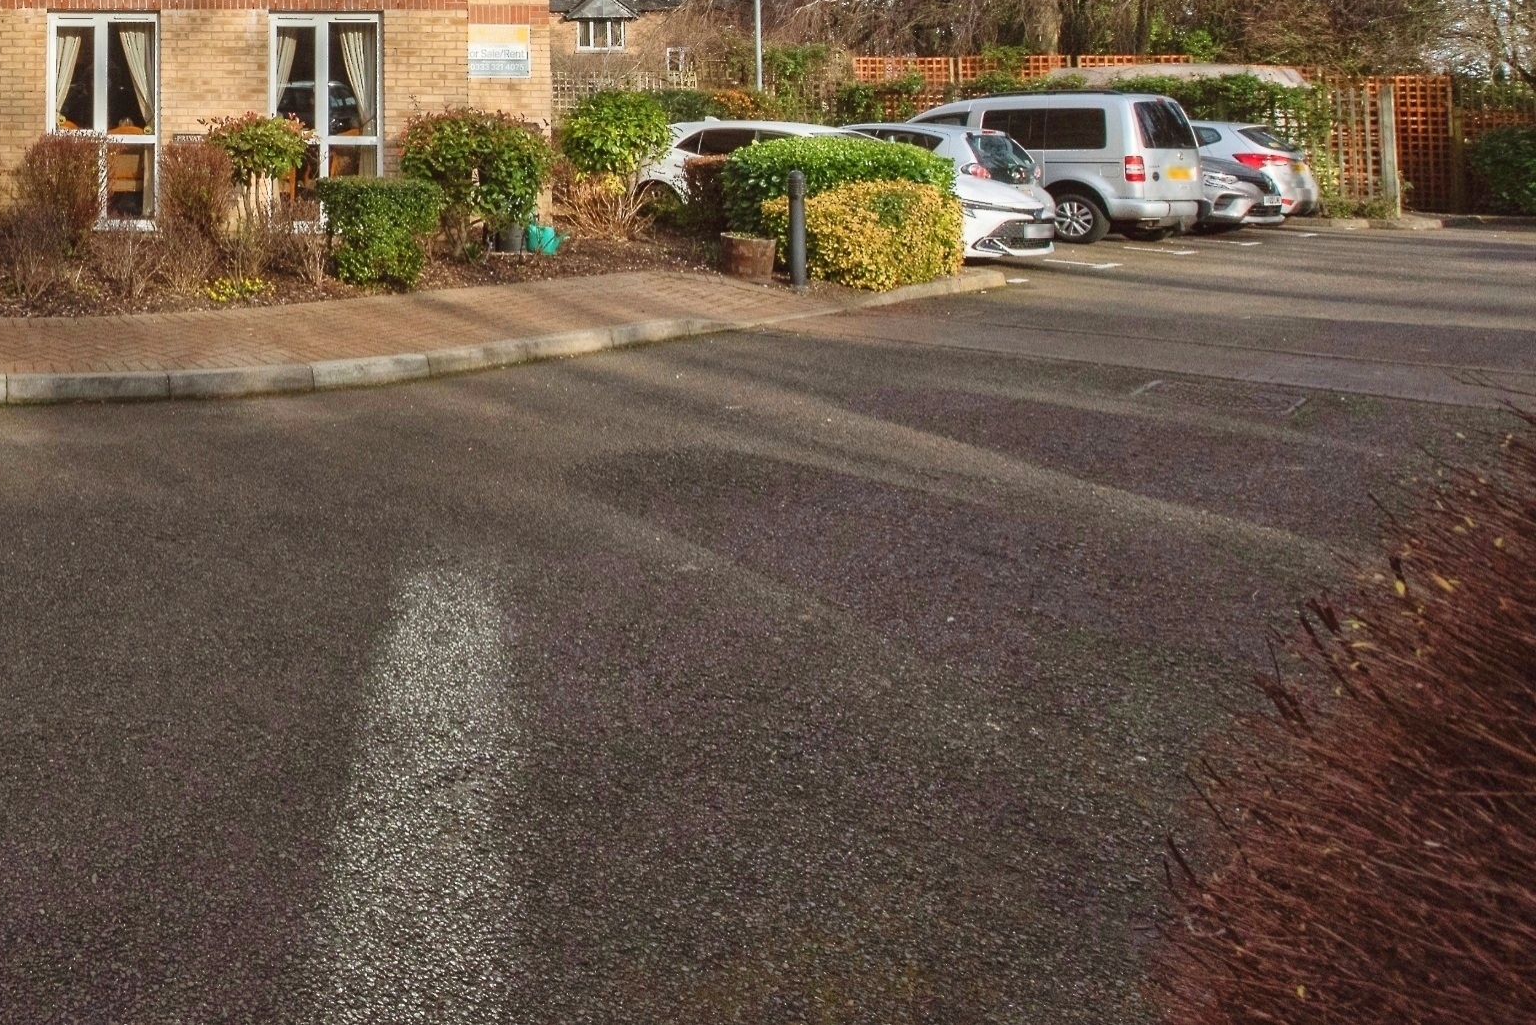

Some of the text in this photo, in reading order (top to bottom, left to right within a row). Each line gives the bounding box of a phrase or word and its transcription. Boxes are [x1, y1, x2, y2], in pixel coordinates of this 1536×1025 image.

[469, 49, 525, 59] or Sale/Rent
[470, 63, 525, 71] 0333 321 4075
[174, 135, 204, 143] PRIVAT
